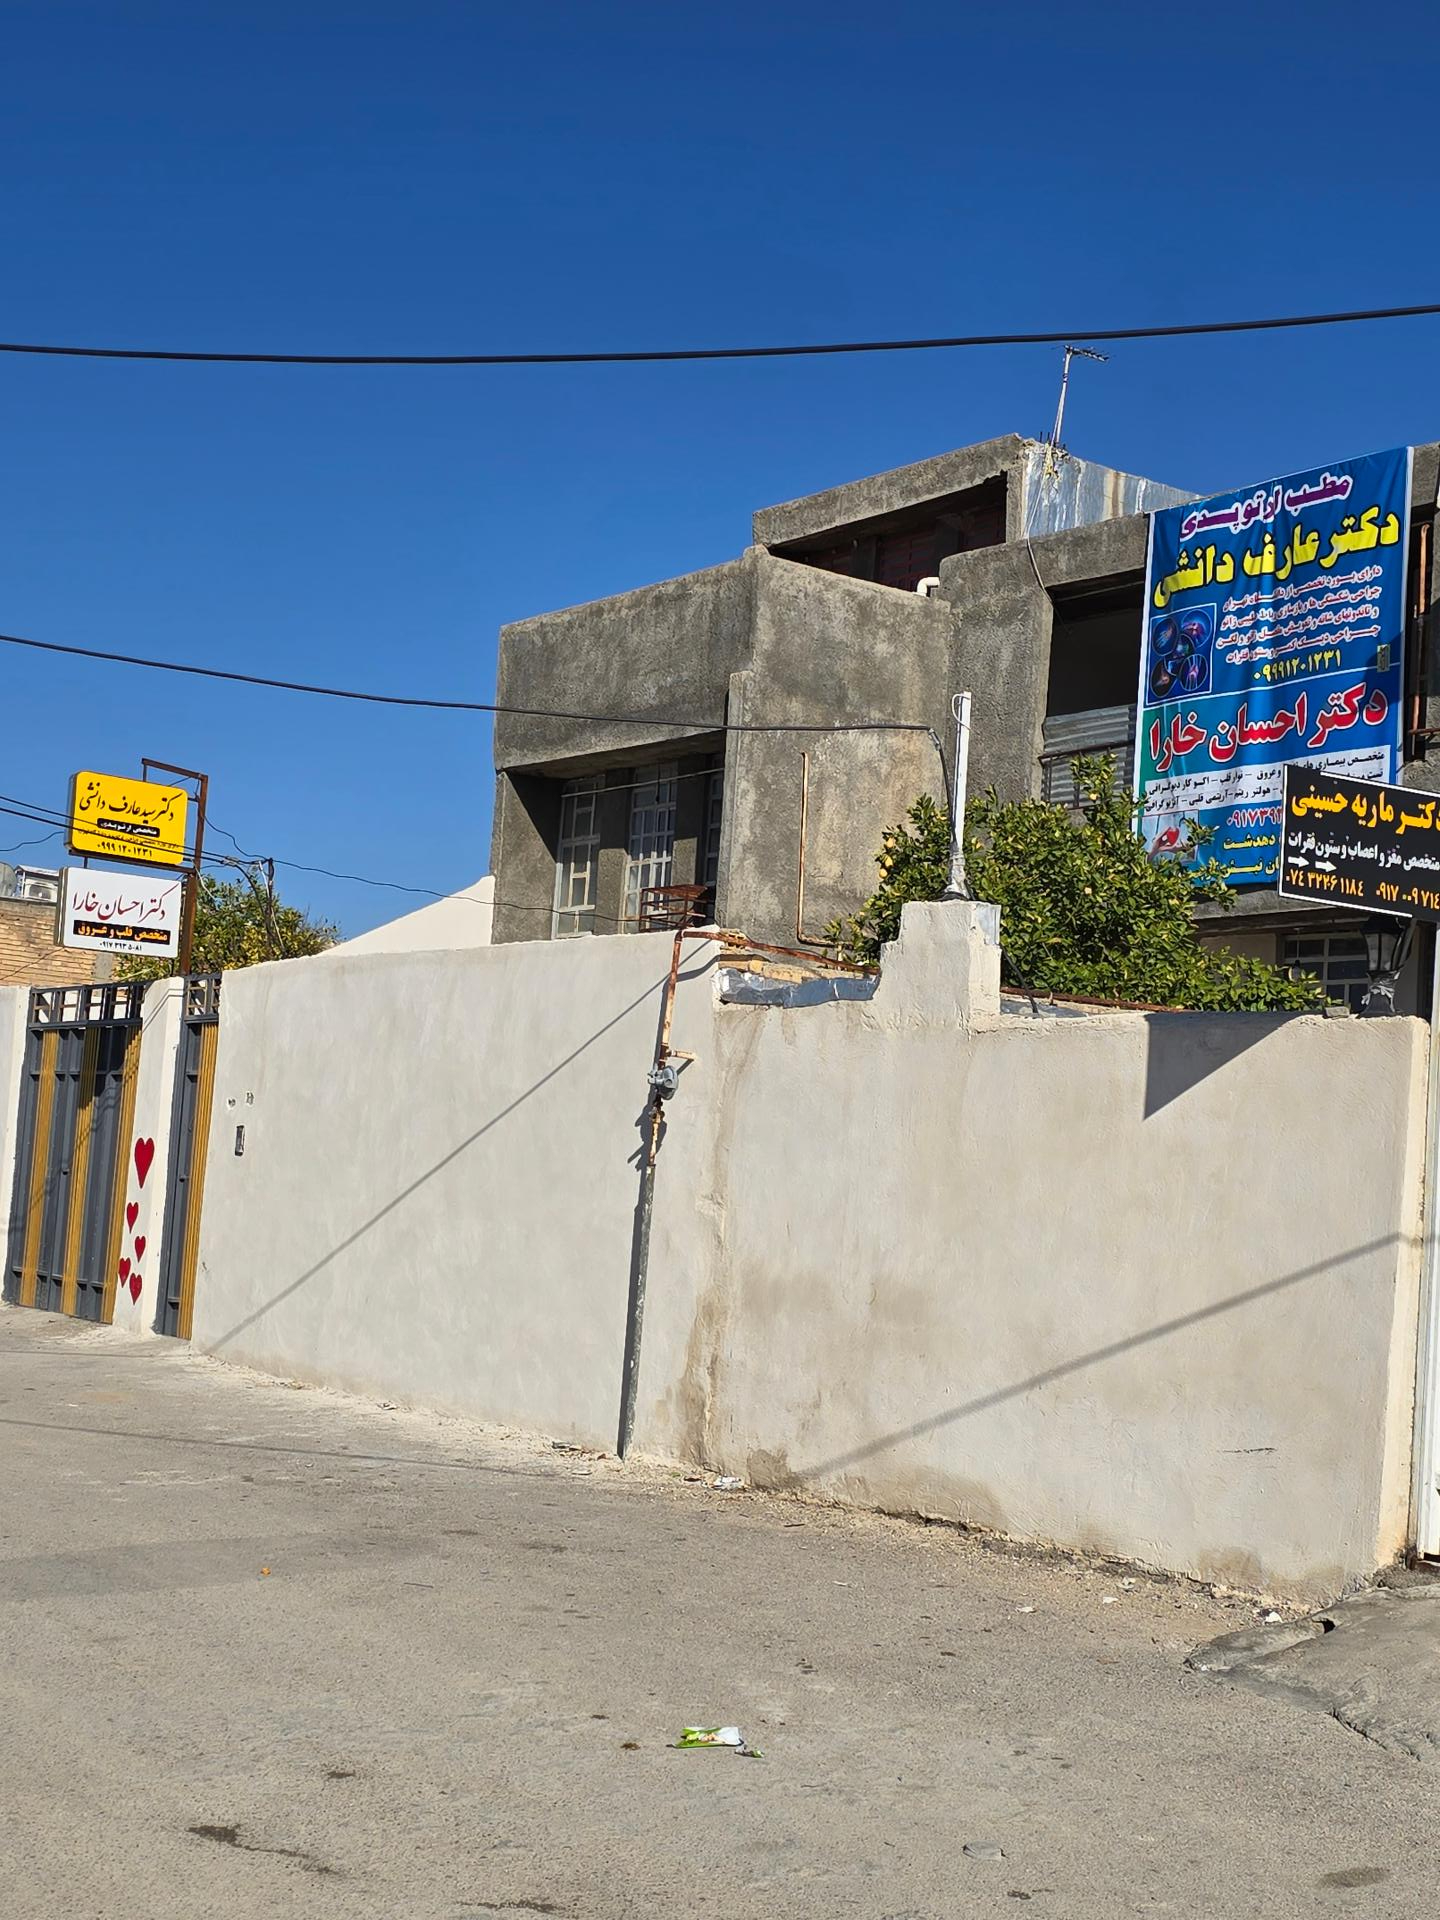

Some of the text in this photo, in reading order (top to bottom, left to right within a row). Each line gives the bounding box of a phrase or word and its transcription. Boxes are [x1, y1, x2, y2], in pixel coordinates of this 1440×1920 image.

[1180, 471, 1353, 541] مطب ارتوپدی
[1153, 505, 1399, 608] دکتر عارف دانشی
[1326, 571, 1357, 588] بورد
[1357, 565, 1383, 583] دارای
[1293, 576, 1327, 596] تخصصی
[1349, 585, 1382, 602] جراحی
[1223, 595, 1249, 612] تهران
[1308, 596, 1317, 609] ها
[1317, 589, 1349, 609] شکستگی
[1317, 610, 1333, 624] شانه
[1370, 606, 1380, 619] و
[1220, 615, 1237, 630] زانو
[1284, 616, 1311, 636] تعویض
[1216, 631, 1239, 649] لگن
[1297, 632, 1330, 649] دیسک
[1330, 625, 1381, 644] جراحی
[1225, 647, 1249, 665] فقرات
[1150, 681, 1389, 773] دکتر احسان خارا
[1315, 757, 1346, 770] بیماری
[1347, 751, 1385, 766] متخصص
[1257, 767, 1277, 780] عروق
[79, 781, 183, 824] دکتر سید عارف دانشی
[1291, 785, 1349, 819] حسینی
[1351, 791, 1394, 828] ماریه
[100, 821, 157, 835] متخصص ارتوپدی
[1223, 833, 1276, 850] دهدشت
[1288, 831, 1316, 853] فقرات
[1315, 838, 1341, 858] ستون
[1348, 840, 1378, 861] اعصاب
[1341, 845, 1347, 859] و
[1379, 852, 1385, 866] و
[1385, 845, 1402, 868] مغز
[1403, 852, 1440, 871] متخصص
[72, 883, 179, 923] دکتر احسان خارا
[77, 923, 168, 942] متخصص قلب و عروق
